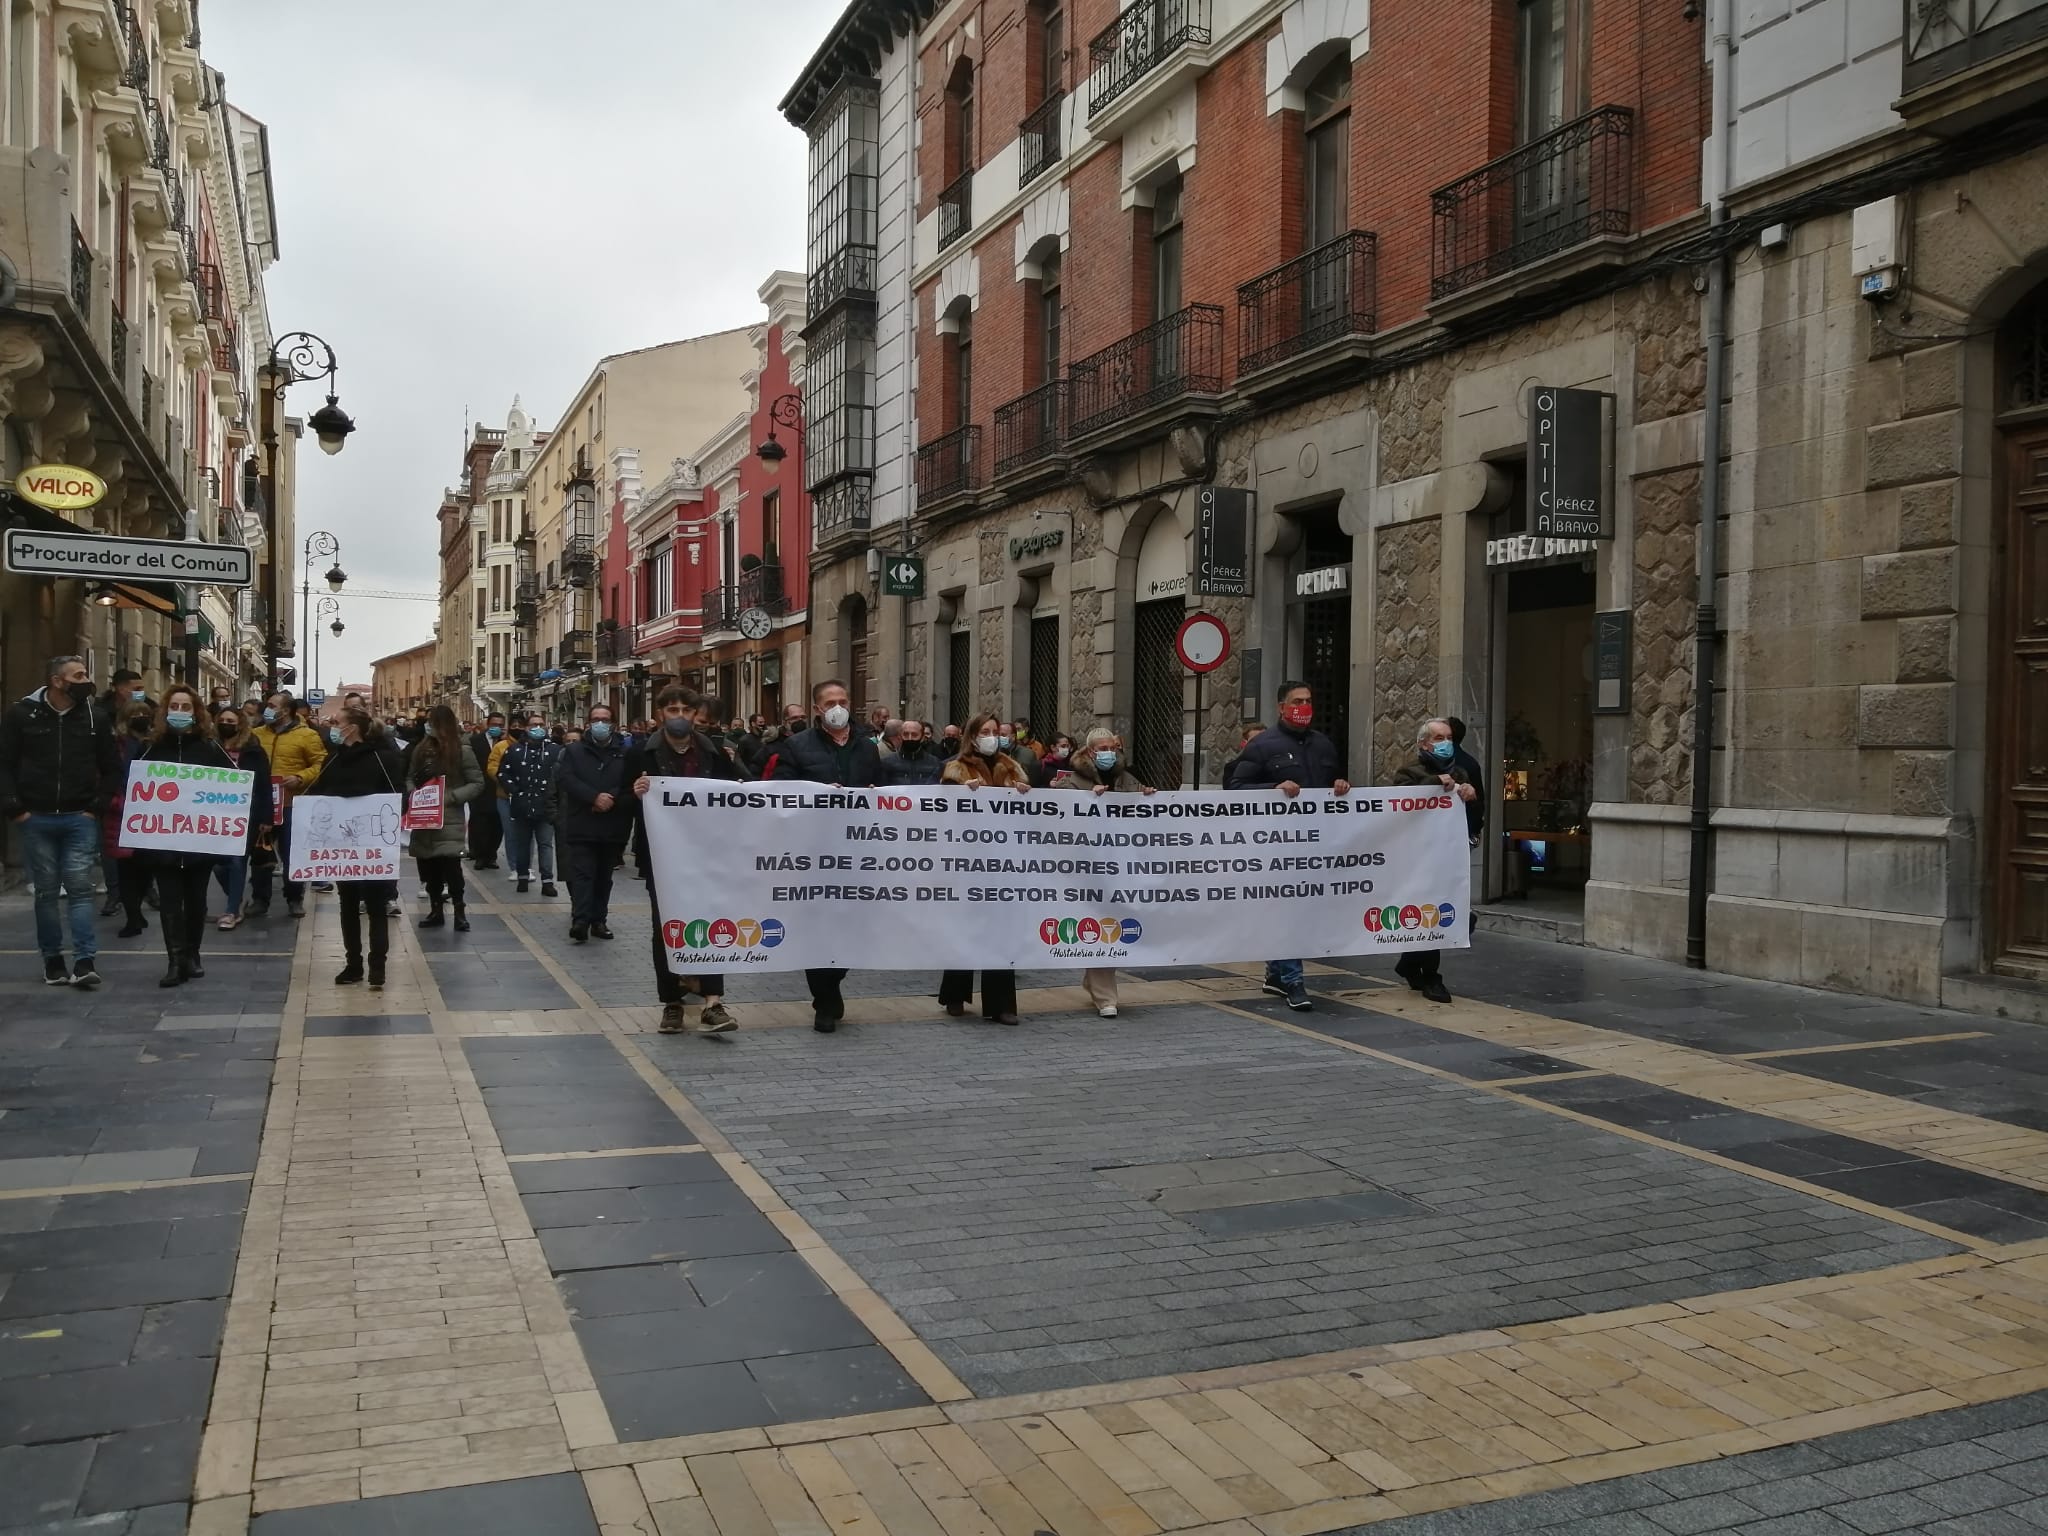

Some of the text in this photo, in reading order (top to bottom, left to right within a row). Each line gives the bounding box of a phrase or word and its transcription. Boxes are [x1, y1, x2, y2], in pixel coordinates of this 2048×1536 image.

[25, 476, 95, 498] VALOR
[1556, 497, 1595, 512] PÉREZ
[1556, 520, 1599, 534] BRAVO
[21, 543, 239, 573] Procurador del Común
[1213, 565, 1241, 578] PÉREZ
[1213, 583, 1244, 594] BRAVO
[147, 763, 252, 784] NOSOTROS
[131, 780, 180, 802] NO
[192, 790, 249, 805] SOMOS
[662, 791, 1453, 820] LA HOSTELERÍA NO ES EL VIRUS, LA RESPONSABILIDAD ES DE TODOS
[126, 813, 248, 838] CULPABLES
[846, 822, 1320, 847] MÁS DE 1.000 TRABAJADORES A LA CALLE
[309, 848, 383, 861] BASTA DE
[755, 852, 1386, 875] MÁS DE 2.000 TRABAJADORES INDIRECTOS AFECTADOS
[772, 879, 1374, 903] EMPRESAS DEL SECTOR SIN AYUDAS DE NINGÚN TIPO
[1416, 932, 1426, 942] de
[729, 951, 742, 962] de
[743, 950, 769, 963] León
[1096, 947, 1107, 957] de
[1107, 946, 1129, 958] León
